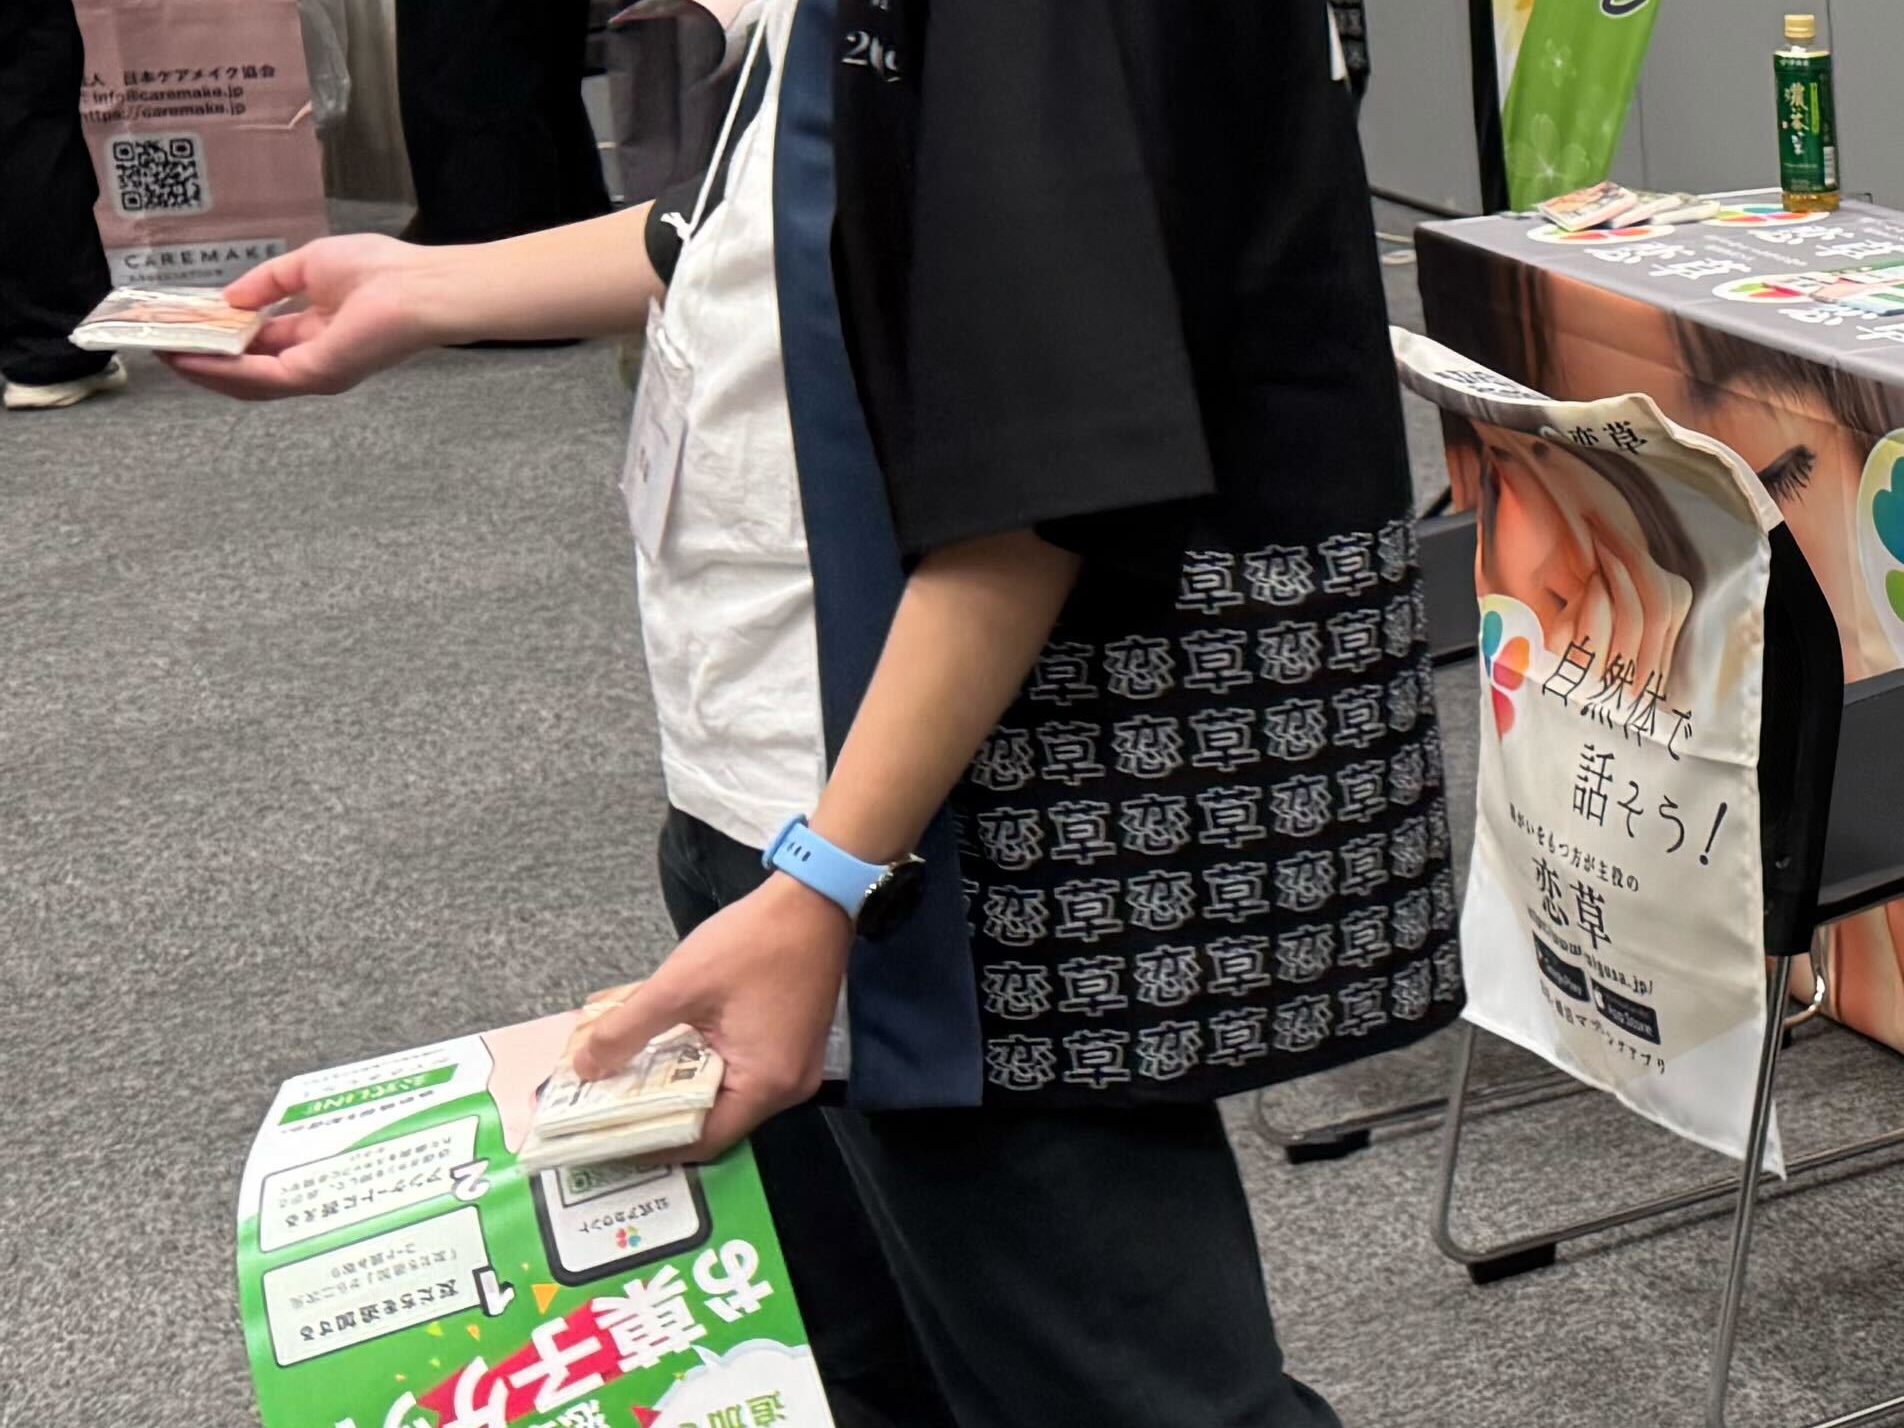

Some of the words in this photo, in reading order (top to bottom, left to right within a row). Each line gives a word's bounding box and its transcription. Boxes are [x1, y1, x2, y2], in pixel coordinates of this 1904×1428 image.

[124, 244, 278, 269] CAREMAKE
[1539, 635, 1695, 762] 自然体で
[1571, 743, 1729, 866] 話そう！
[1531, 856, 1612, 950] 恋草
